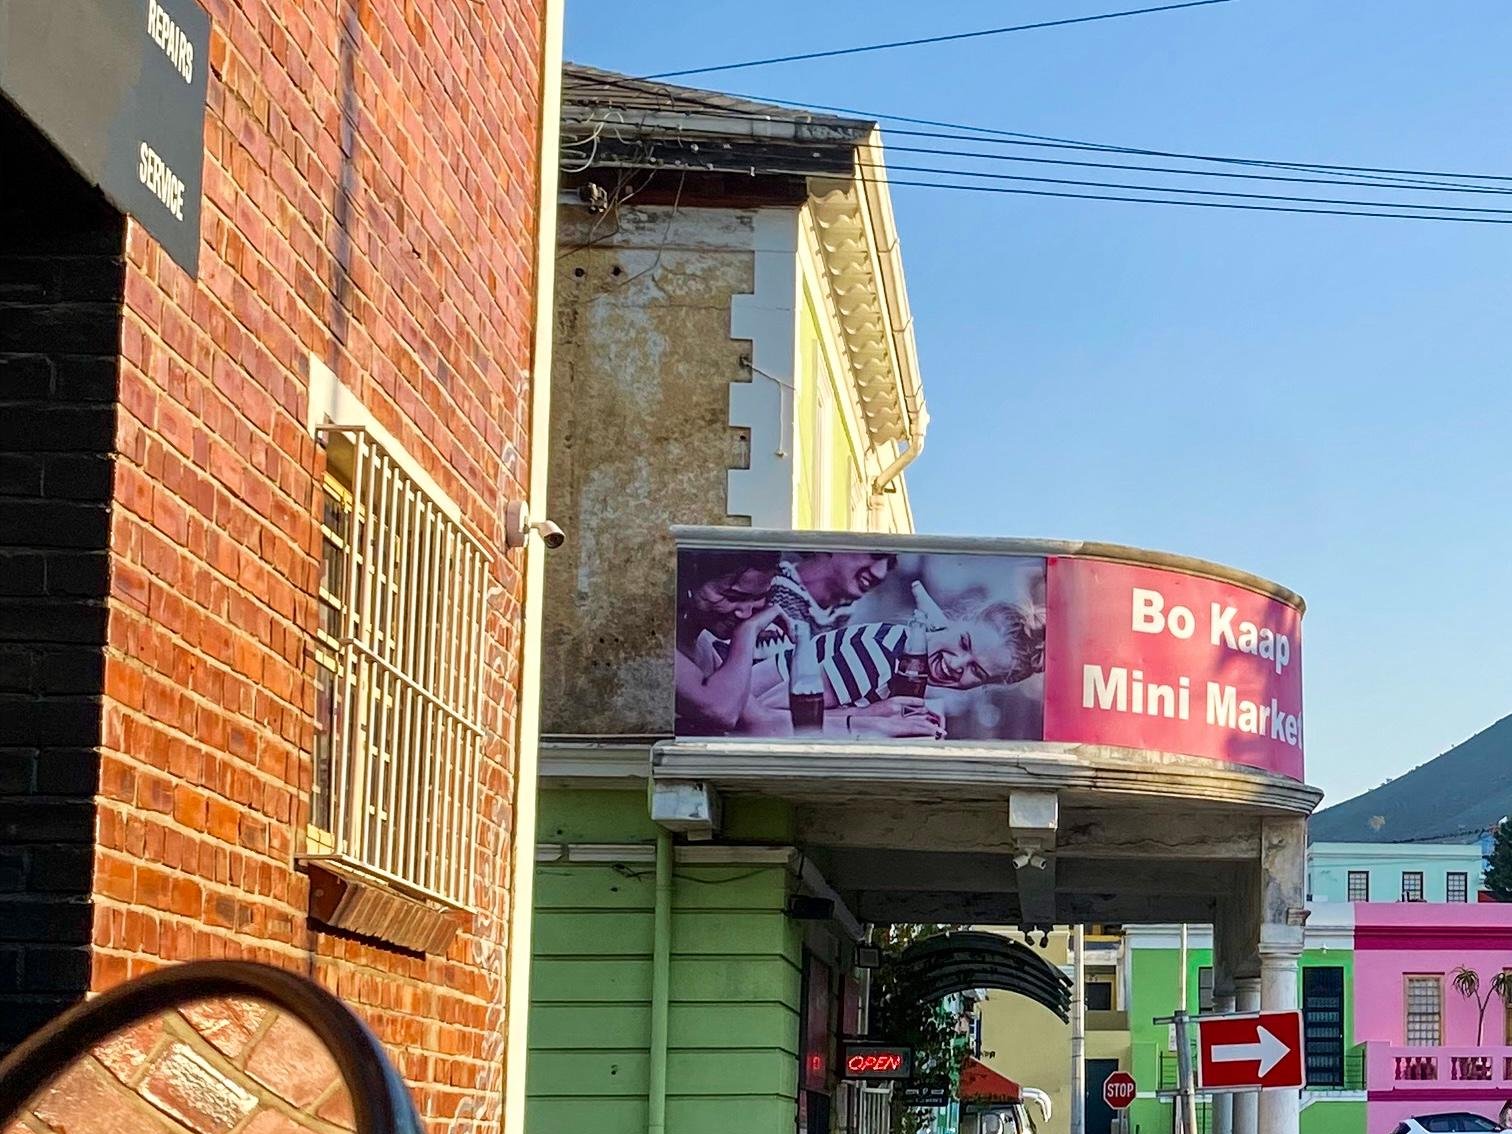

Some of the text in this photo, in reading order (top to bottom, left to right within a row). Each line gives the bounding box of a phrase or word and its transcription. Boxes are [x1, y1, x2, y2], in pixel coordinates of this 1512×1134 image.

[147, 0, 195, 84] REPAIRS
[138, 141, 185, 222] SERVICE
[1131, 587, 1290, 675] Bo Kaap
[1082, 664, 1190, 721] Mini
[848, 1055, 903, 1071] OPEN
[1107, 1082, 1134, 1098] STOP
